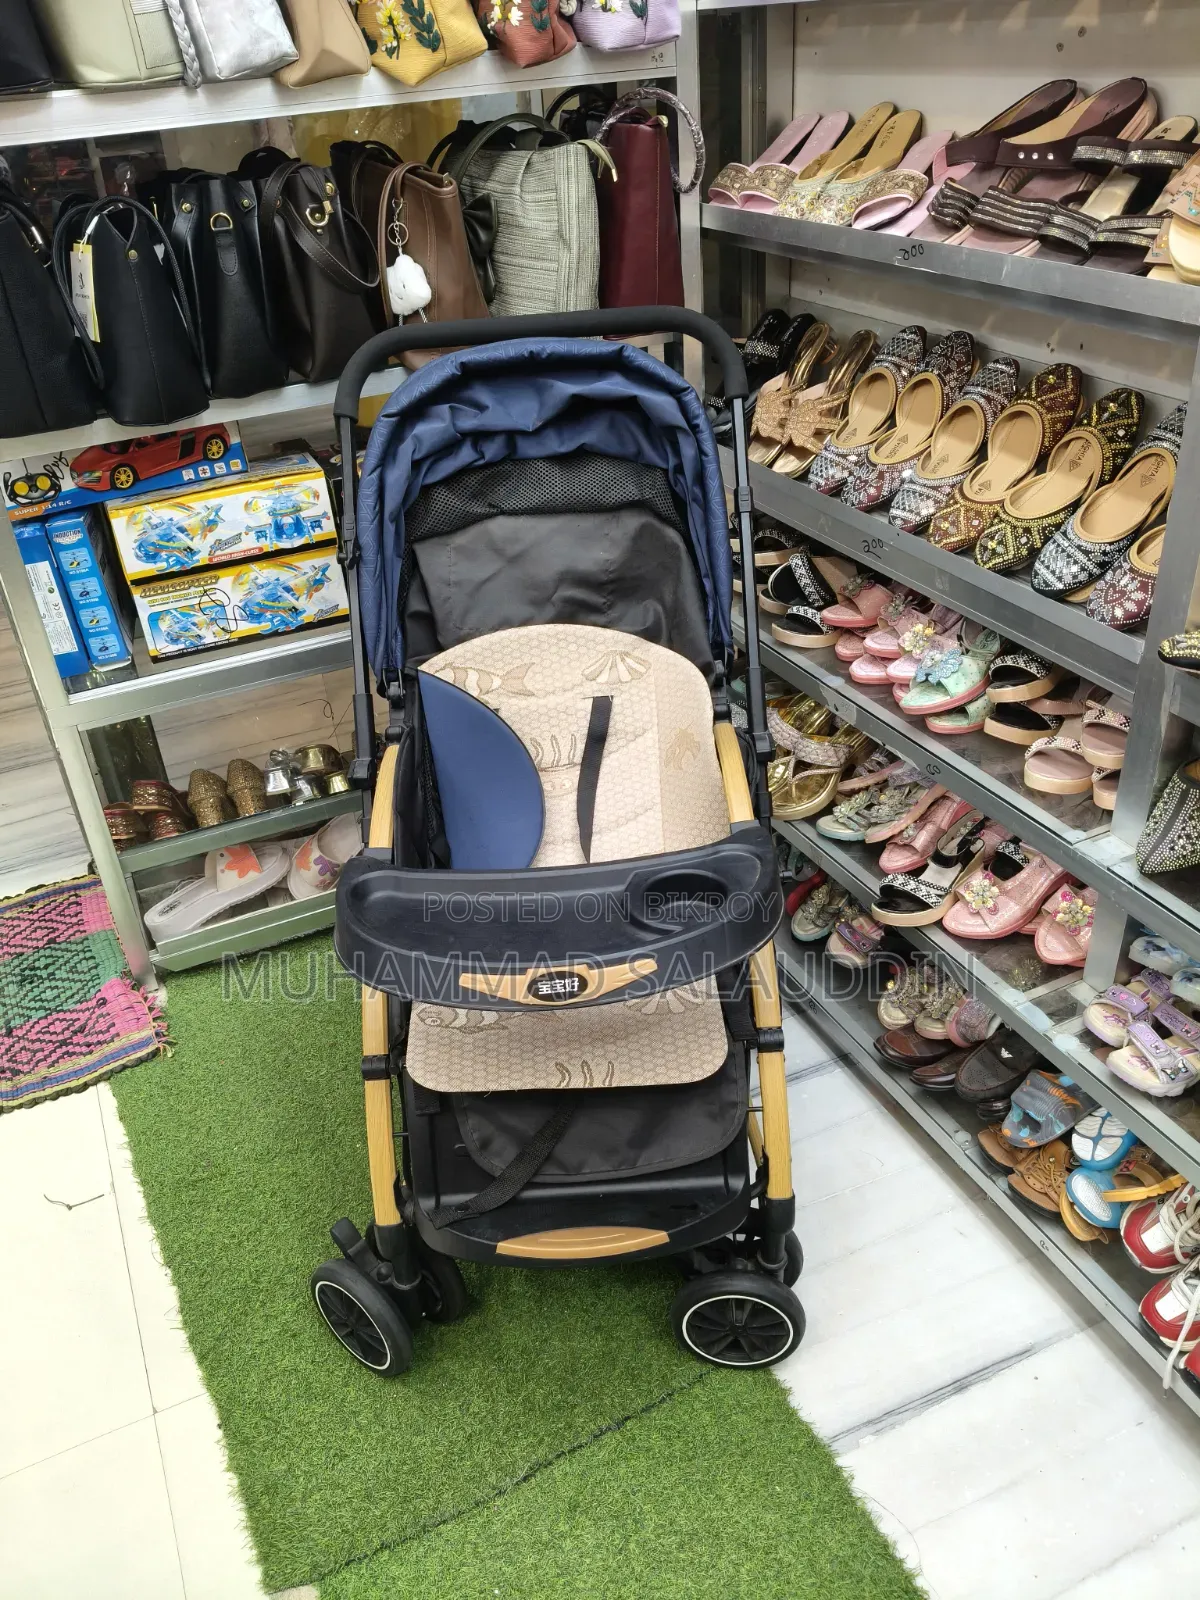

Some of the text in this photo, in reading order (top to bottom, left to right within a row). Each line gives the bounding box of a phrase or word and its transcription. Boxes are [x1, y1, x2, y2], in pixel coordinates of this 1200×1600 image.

[14, 507, 39, 516] SUPER
[41, 502, 57, 510] 1:14
[53, 528, 81, 539] INDUCTION
[212, 554, 230, 562] WORLD
[537, 977, 580, 995] 宝宝好
